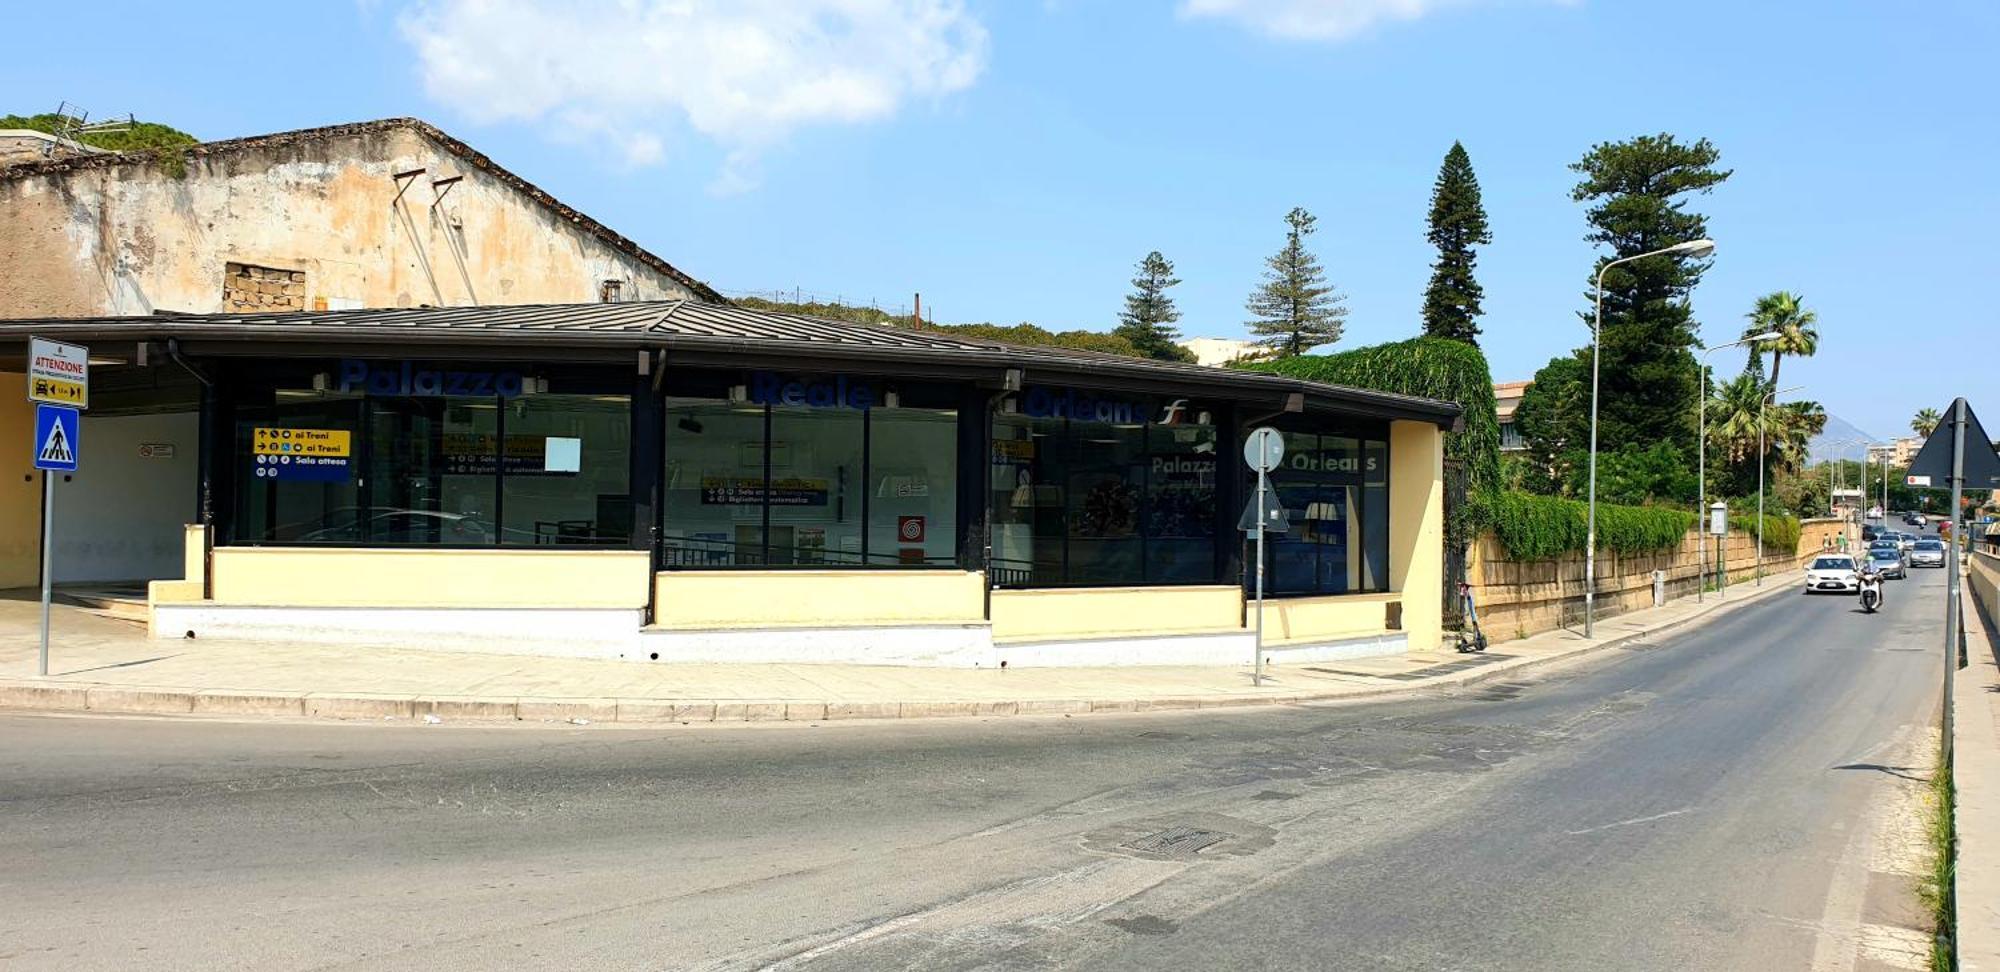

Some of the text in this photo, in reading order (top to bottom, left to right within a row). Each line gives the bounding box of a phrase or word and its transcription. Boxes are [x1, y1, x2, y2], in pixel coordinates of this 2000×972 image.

[35, 356, 84, 374] ATTENZIONE
[338, 359, 522, 398] Palazzo
[751, 370, 875, 409] Reale
[1024, 387, 1148, 424] Orleans
[295, 431, 329, 440] ai Treni
[307, 444, 341, 453] ai Treni
[295, 456, 316, 464] Sala
